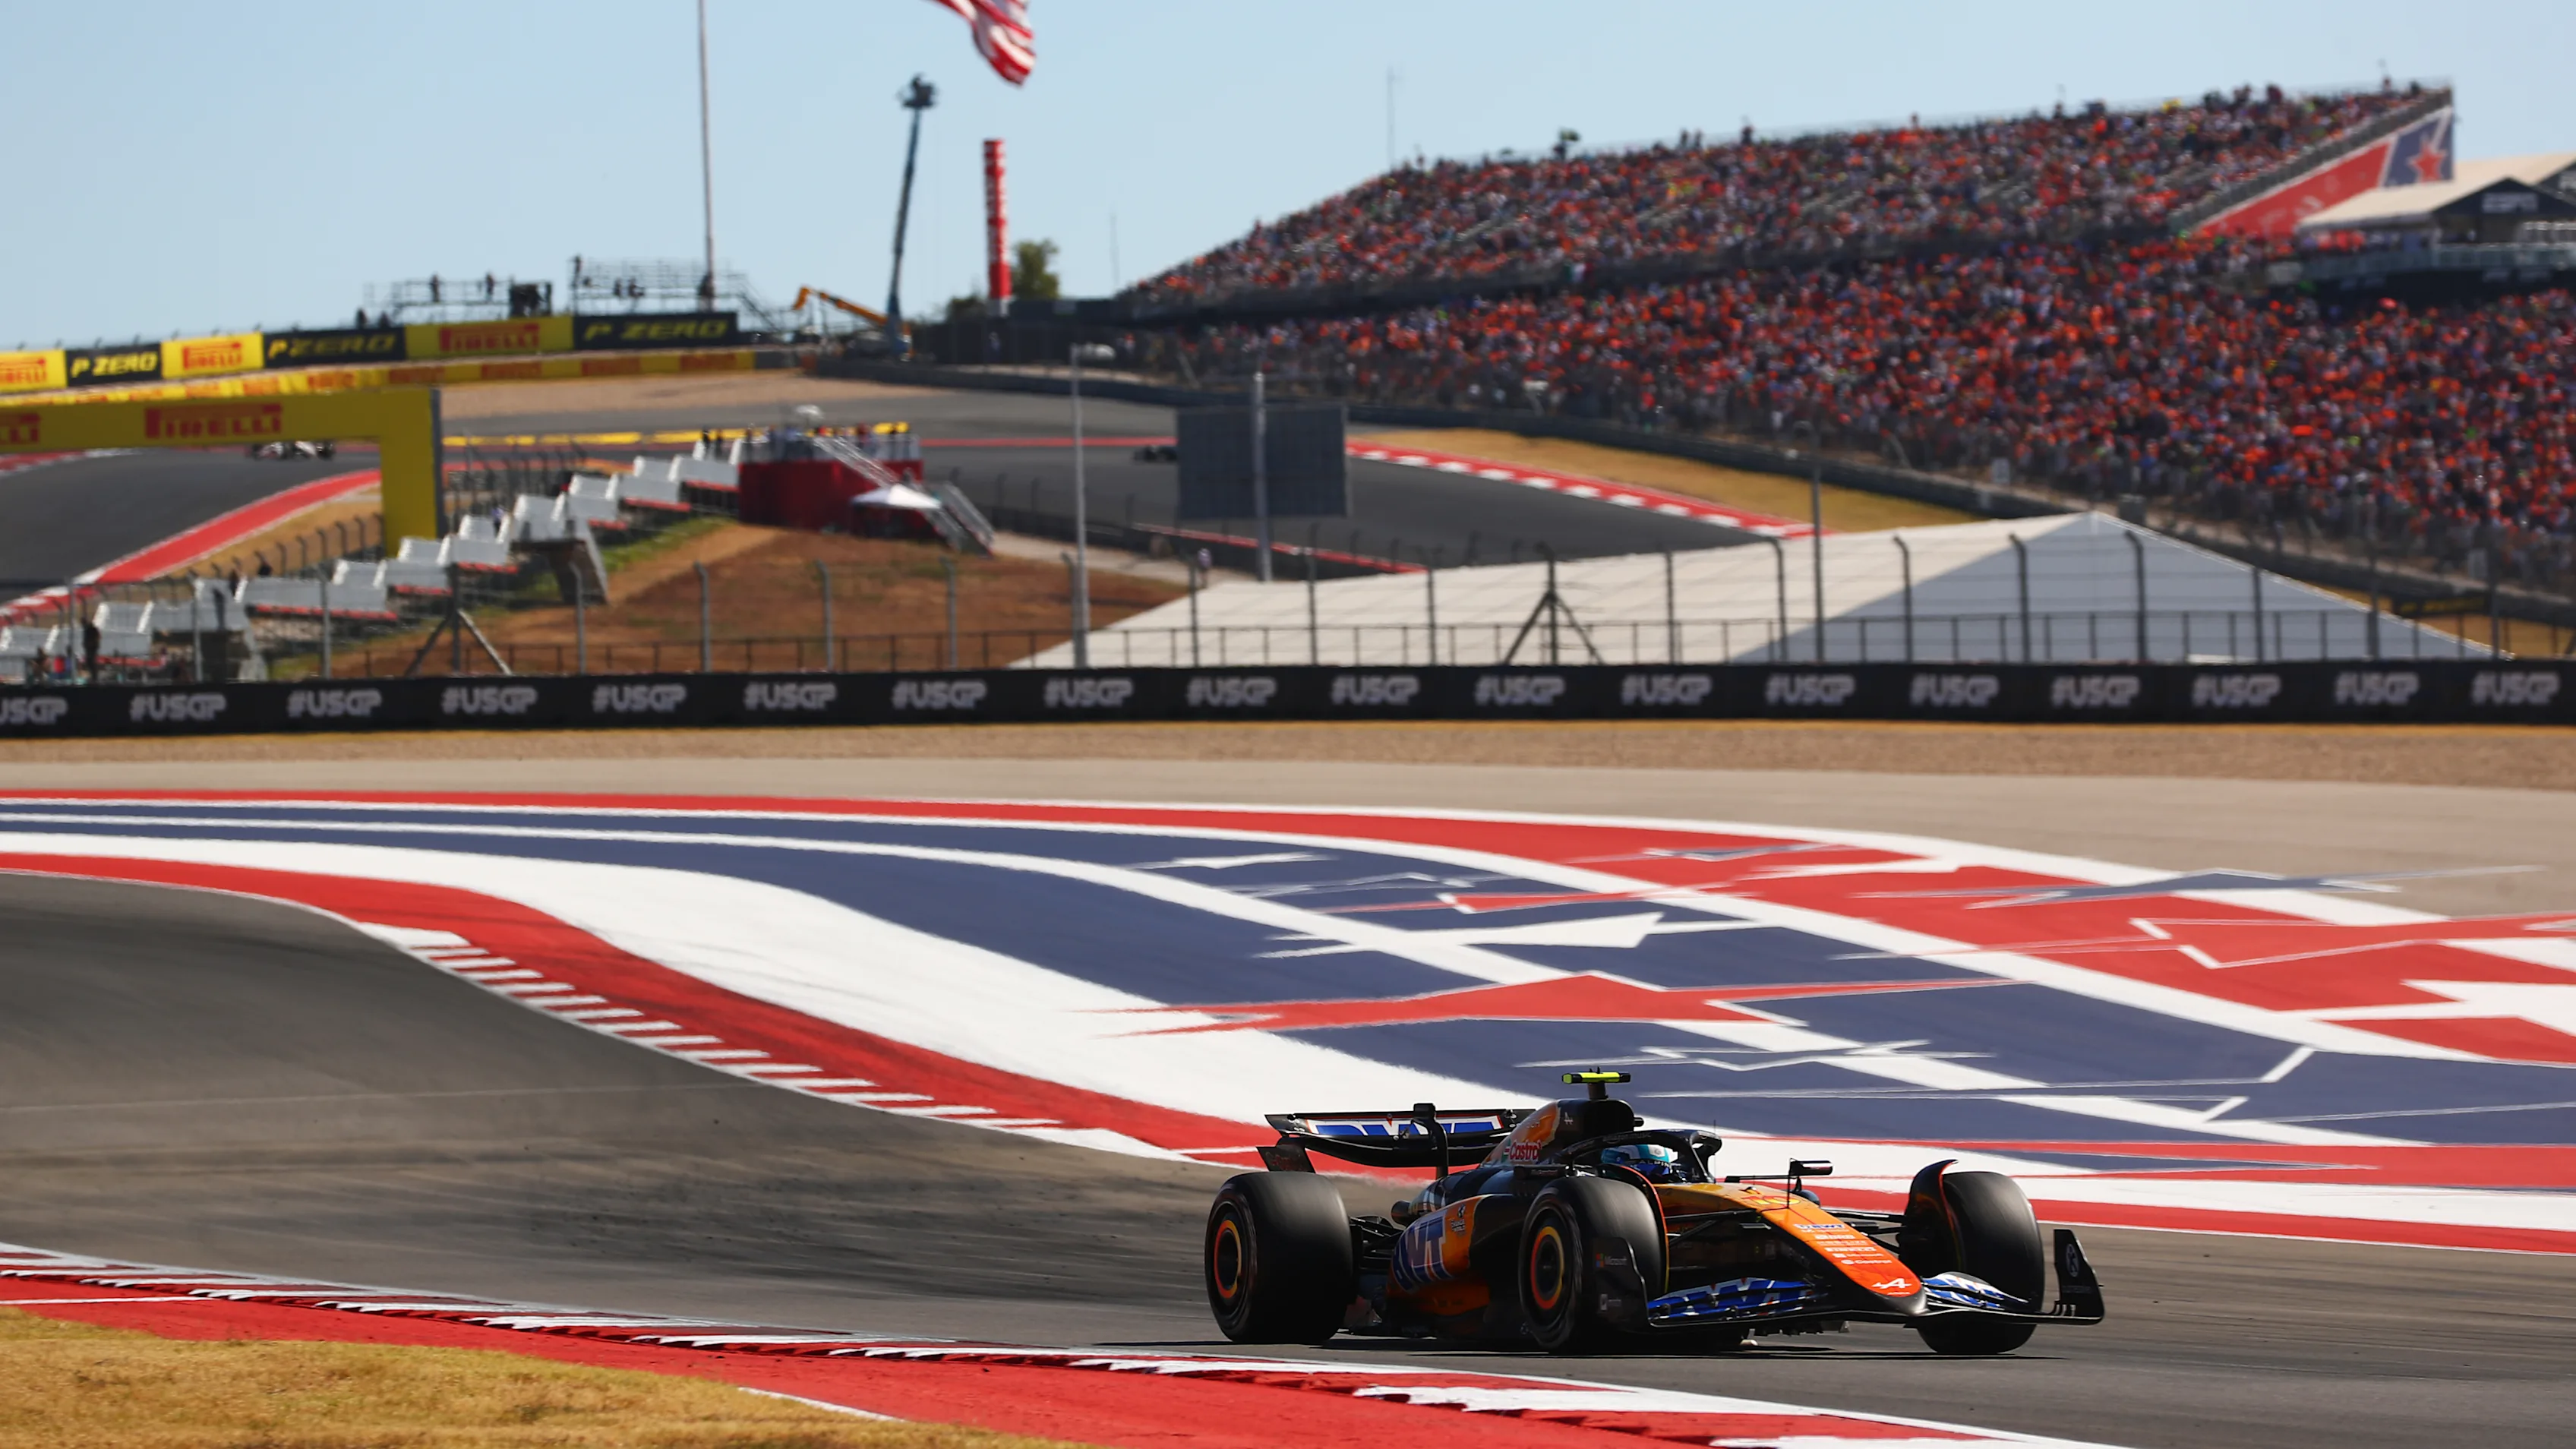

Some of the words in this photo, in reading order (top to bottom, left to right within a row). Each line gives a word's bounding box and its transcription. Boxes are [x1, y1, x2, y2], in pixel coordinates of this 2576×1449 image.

[439, 323, 540, 352] PIRELLI
[583, 322, 613, 340] P
[620, 320, 728, 340] ZERO
[71, 357, 90, 378] P
[93, 352, 157, 376] ZERO
[182, 342, 242, 370] PIRELLI
[268, 339, 287, 361] P
[144, 403, 283, 439] PIRELLI
[441, 686, 538, 714] #USGP
[592, 683, 687, 712] #USGP
[743, 682, 837, 709] #USGP
[892, 680, 987, 709] #USGP
[1043, 677, 1134, 707] #USGP
[1186, 676, 1277, 706] #USGP
[1331, 674, 1419, 704] #USGP
[1474, 675, 1565, 705] #USGP
[1621, 674, 1713, 704] #USGP
[1765, 674, 1855, 704] #USGP
[1910, 674, 2000, 706] #USGP
[2051, 675, 2140, 707] #USGP
[2192, 674, 2281, 706] #USGP
[2334, 672, 2420, 704] #USGP
[2472, 671, 2559, 704] #USGP
[129, 693, 227, 720] #USGP
[287, 689, 383, 717] #USGP
